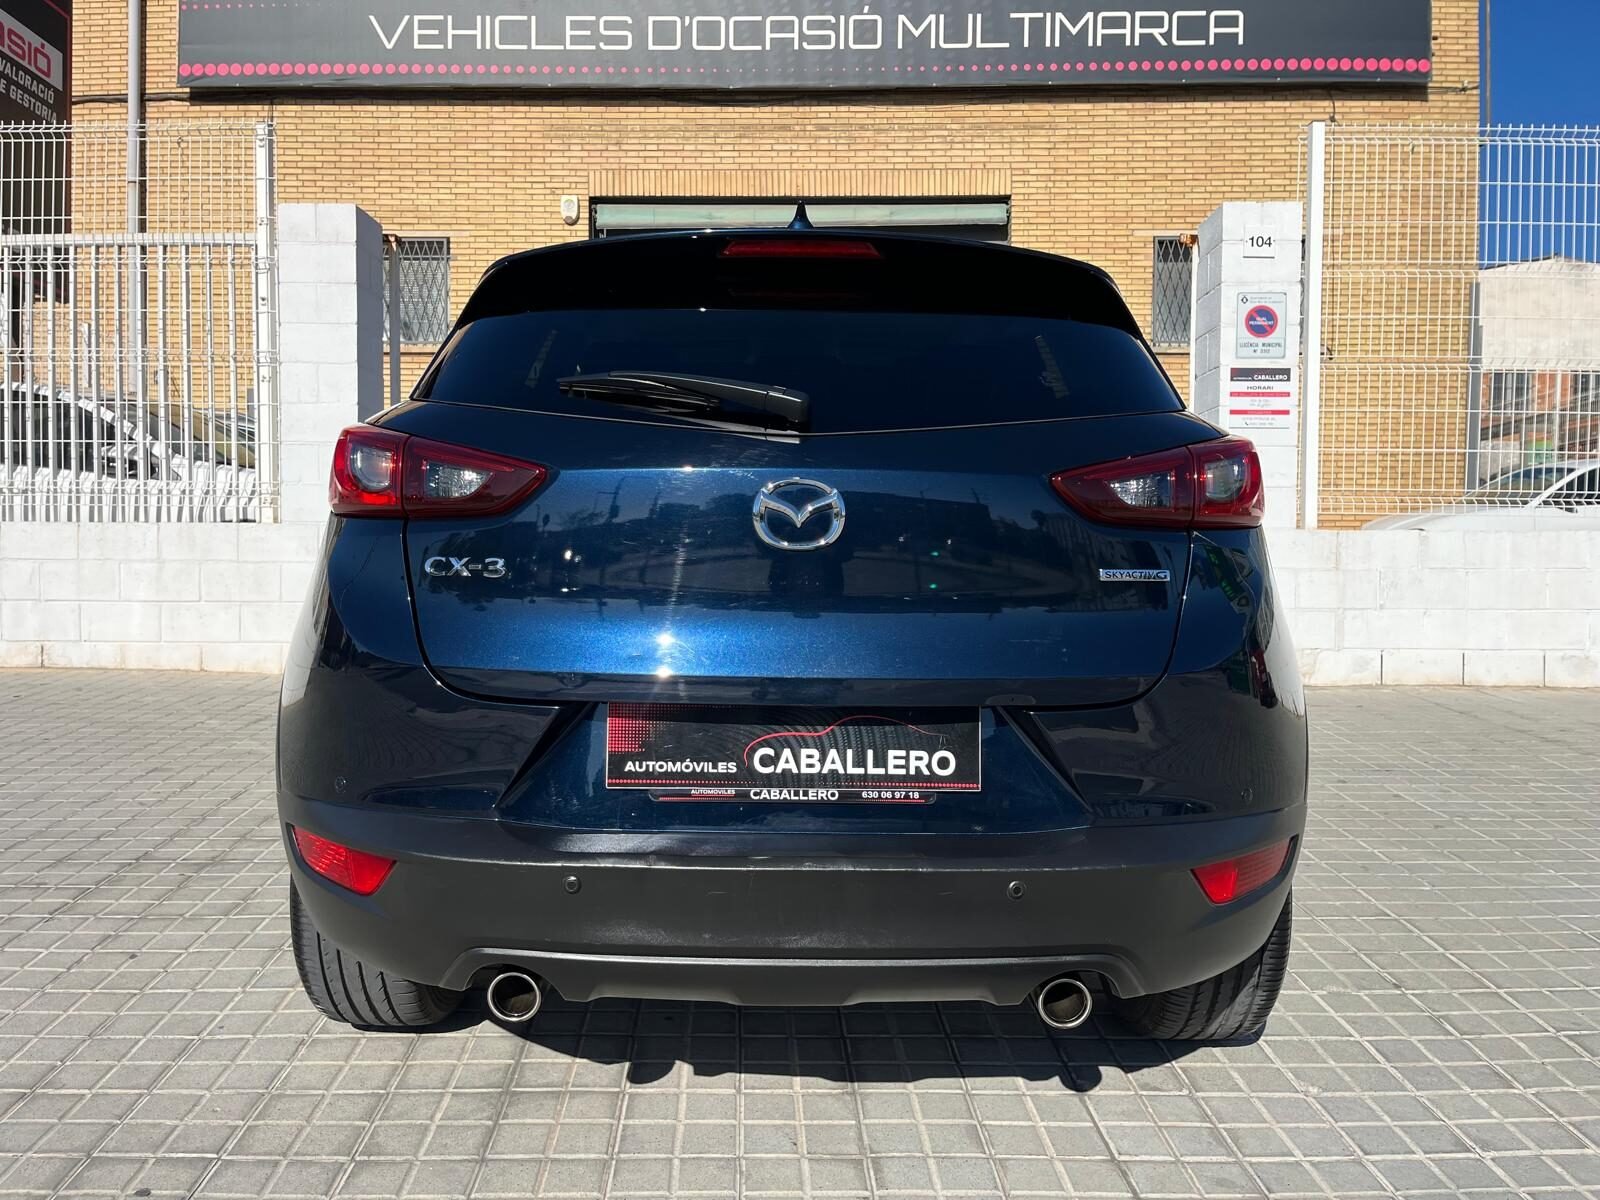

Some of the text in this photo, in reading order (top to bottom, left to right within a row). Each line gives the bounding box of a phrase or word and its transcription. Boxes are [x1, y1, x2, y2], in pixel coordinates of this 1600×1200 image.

[369, 6, 1244, 51] VEHICLES D'OCASIÓ MULTIMARCA
[1249, 236, 1272, 247] 104
[424, 556, 506, 578] CX-3
[624, 748, 956, 776] AUTOMÓVILES CABALLERO
[750, 789, 839, 801] CABALLERO
[861, 790, 879, 799] 630
[881, 791, 893, 799] 06
[894, 791, 906, 799] 97
[908, 791, 920, 799] 18
